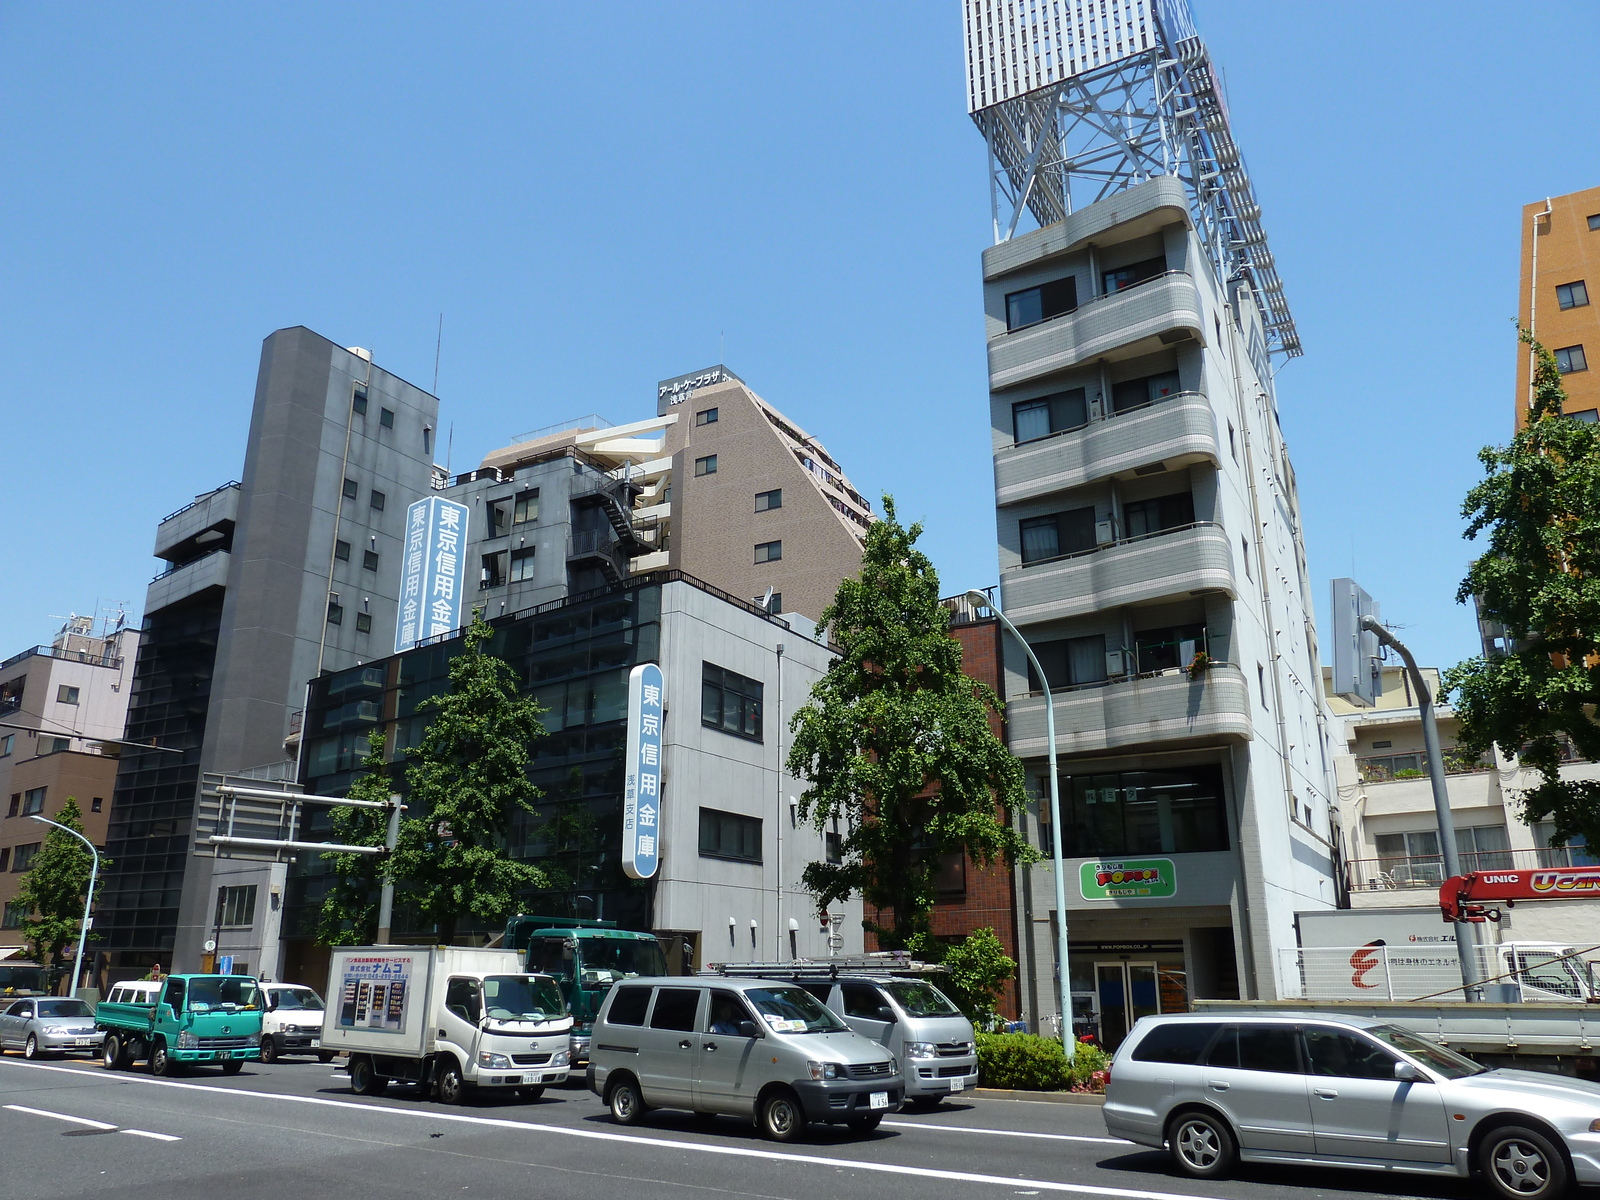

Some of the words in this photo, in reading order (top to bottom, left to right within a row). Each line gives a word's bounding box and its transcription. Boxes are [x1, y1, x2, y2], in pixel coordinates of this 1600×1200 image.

[400, 504, 427, 647] 東京信用金庫
[637, 684, 660, 858] 東京信用金庫
[624, 773, 636, 830] 浅草支店
[1483, 874, 1519, 884] UNIC
[372, 963, 403, 974] ナムコ
